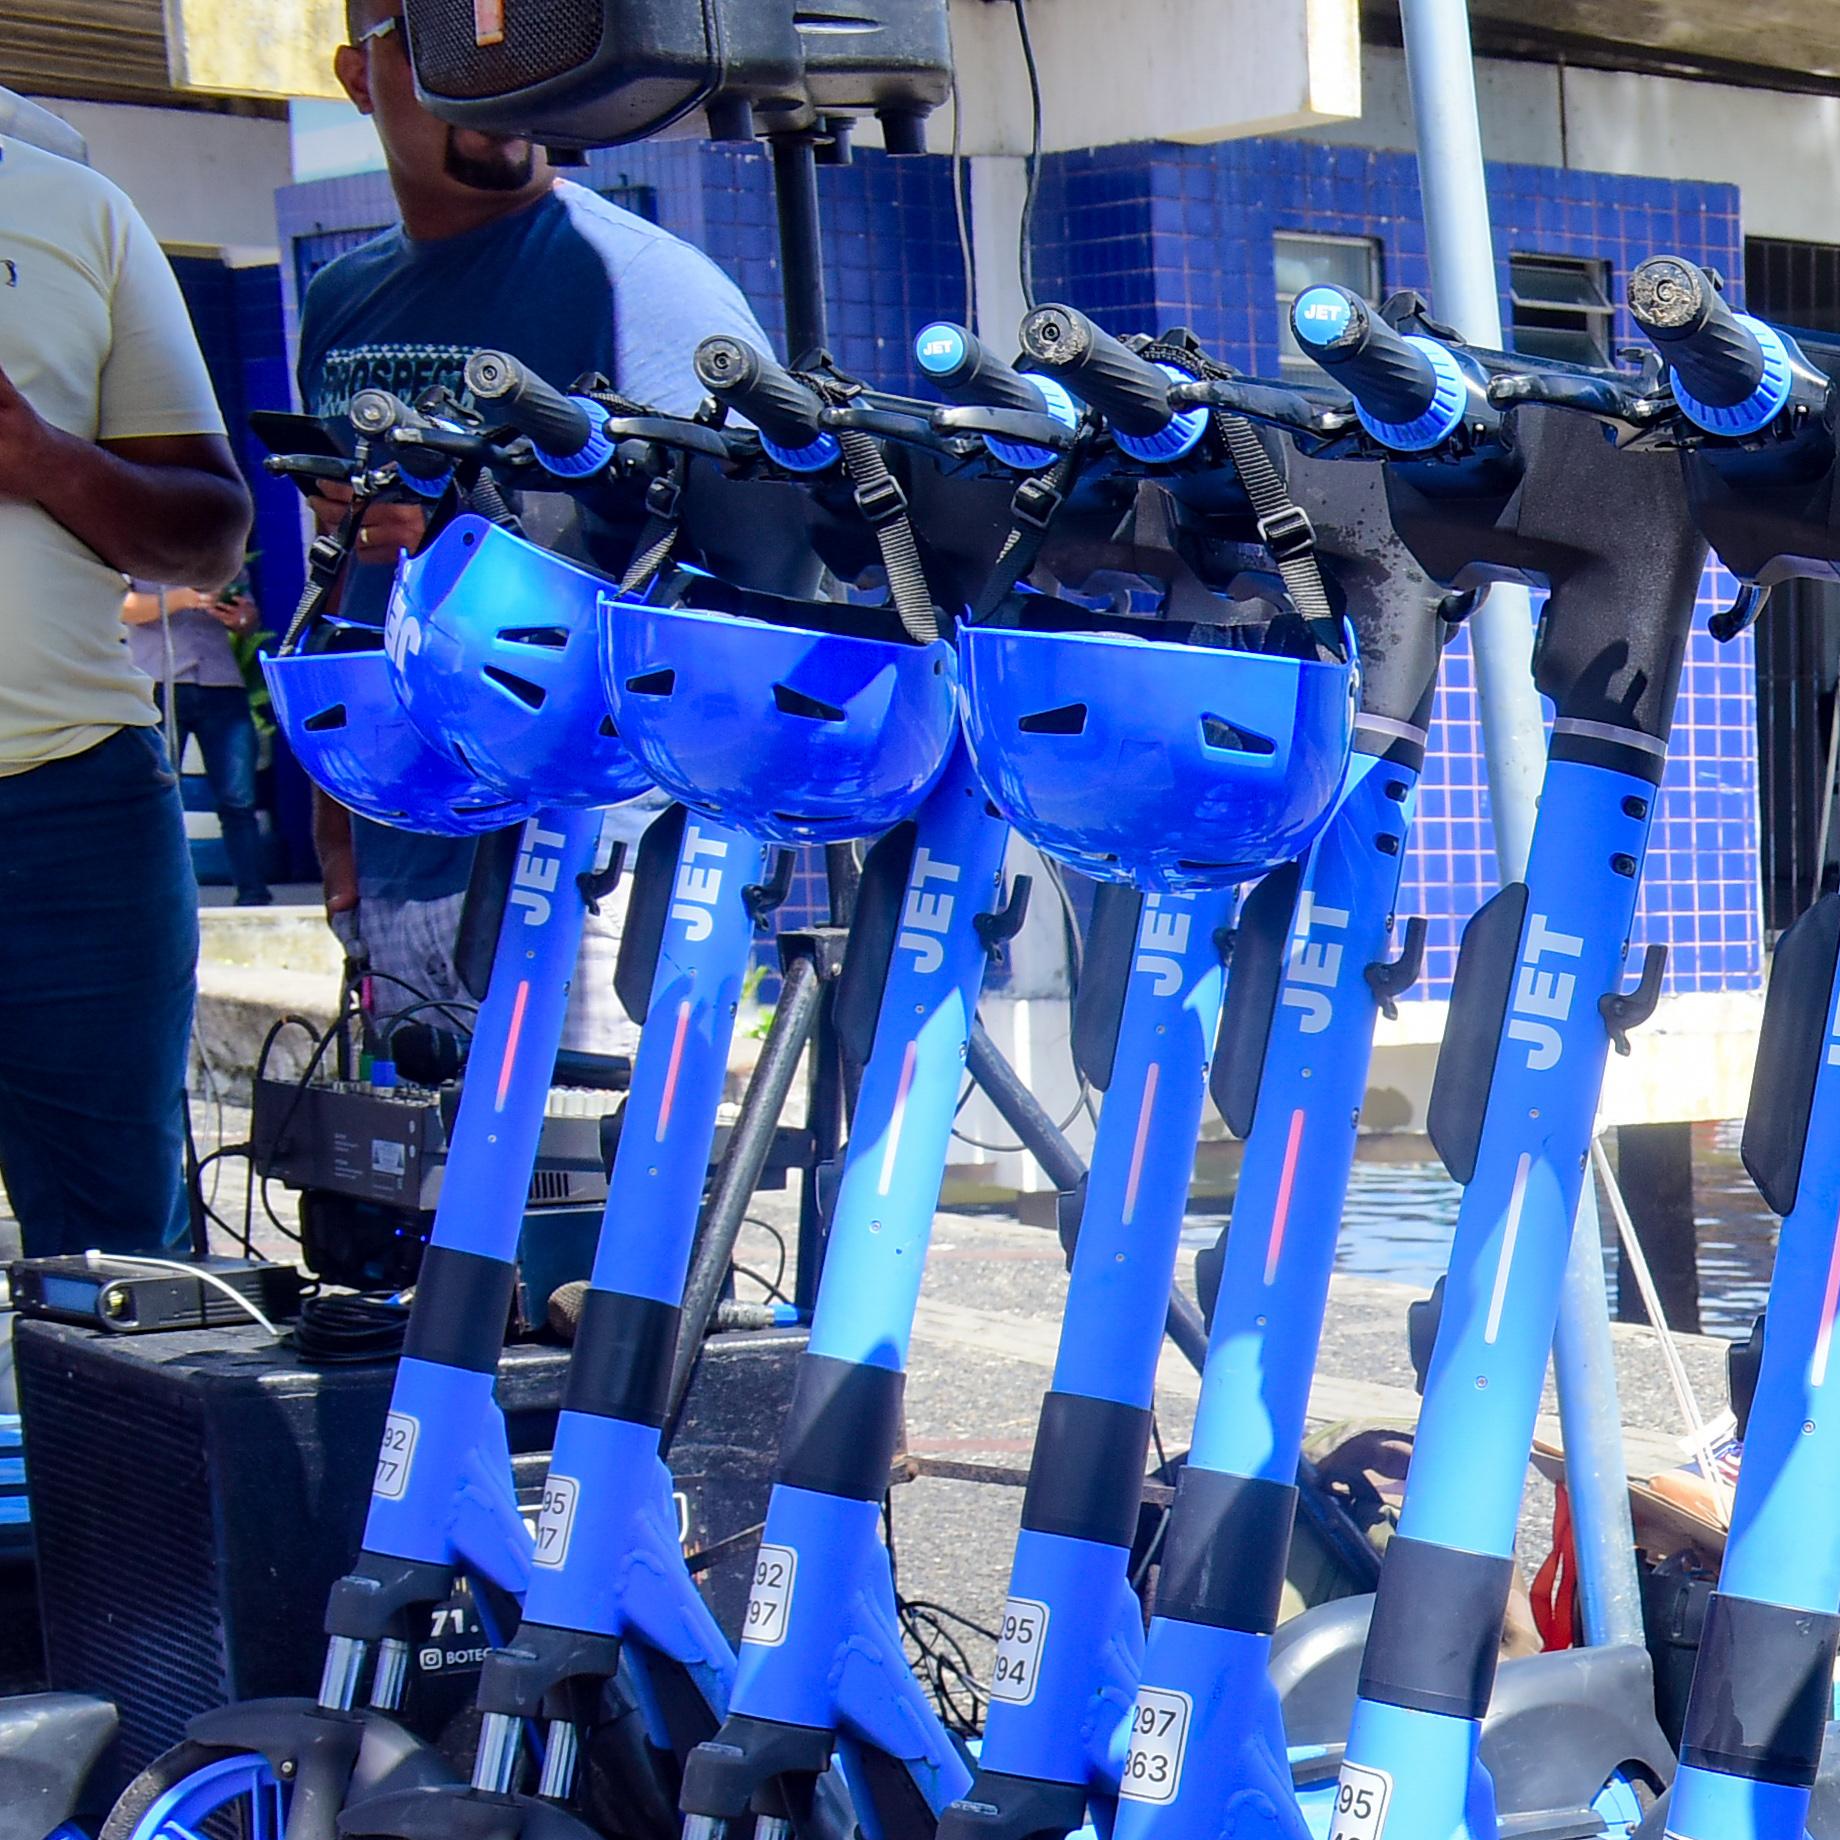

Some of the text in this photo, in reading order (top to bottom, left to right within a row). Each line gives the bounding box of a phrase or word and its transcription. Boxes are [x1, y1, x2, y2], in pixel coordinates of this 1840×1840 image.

[1304, 302, 1342, 324] JET
[922, 340, 954, 357] JET
[510, 817, 566, 927] JET
[671, 825, 729, 943] JET
[898, 846, 961, 974] JET
[1281, 889, 1353, 1034] JET
[1507, 913, 1584, 1072] JET
[382, 1427, 406, 1451] 92
[377, 1459, 399, 1482] 77
[542, 1490, 567, 1515] 95
[539, 1526, 558, 1550] 17
[753, 1561, 784, 1588] 92
[748, 1599, 777, 1626] 97
[994, 1659, 1026, 1700] 94
[1336, 1783, 1374, 1820] 95
